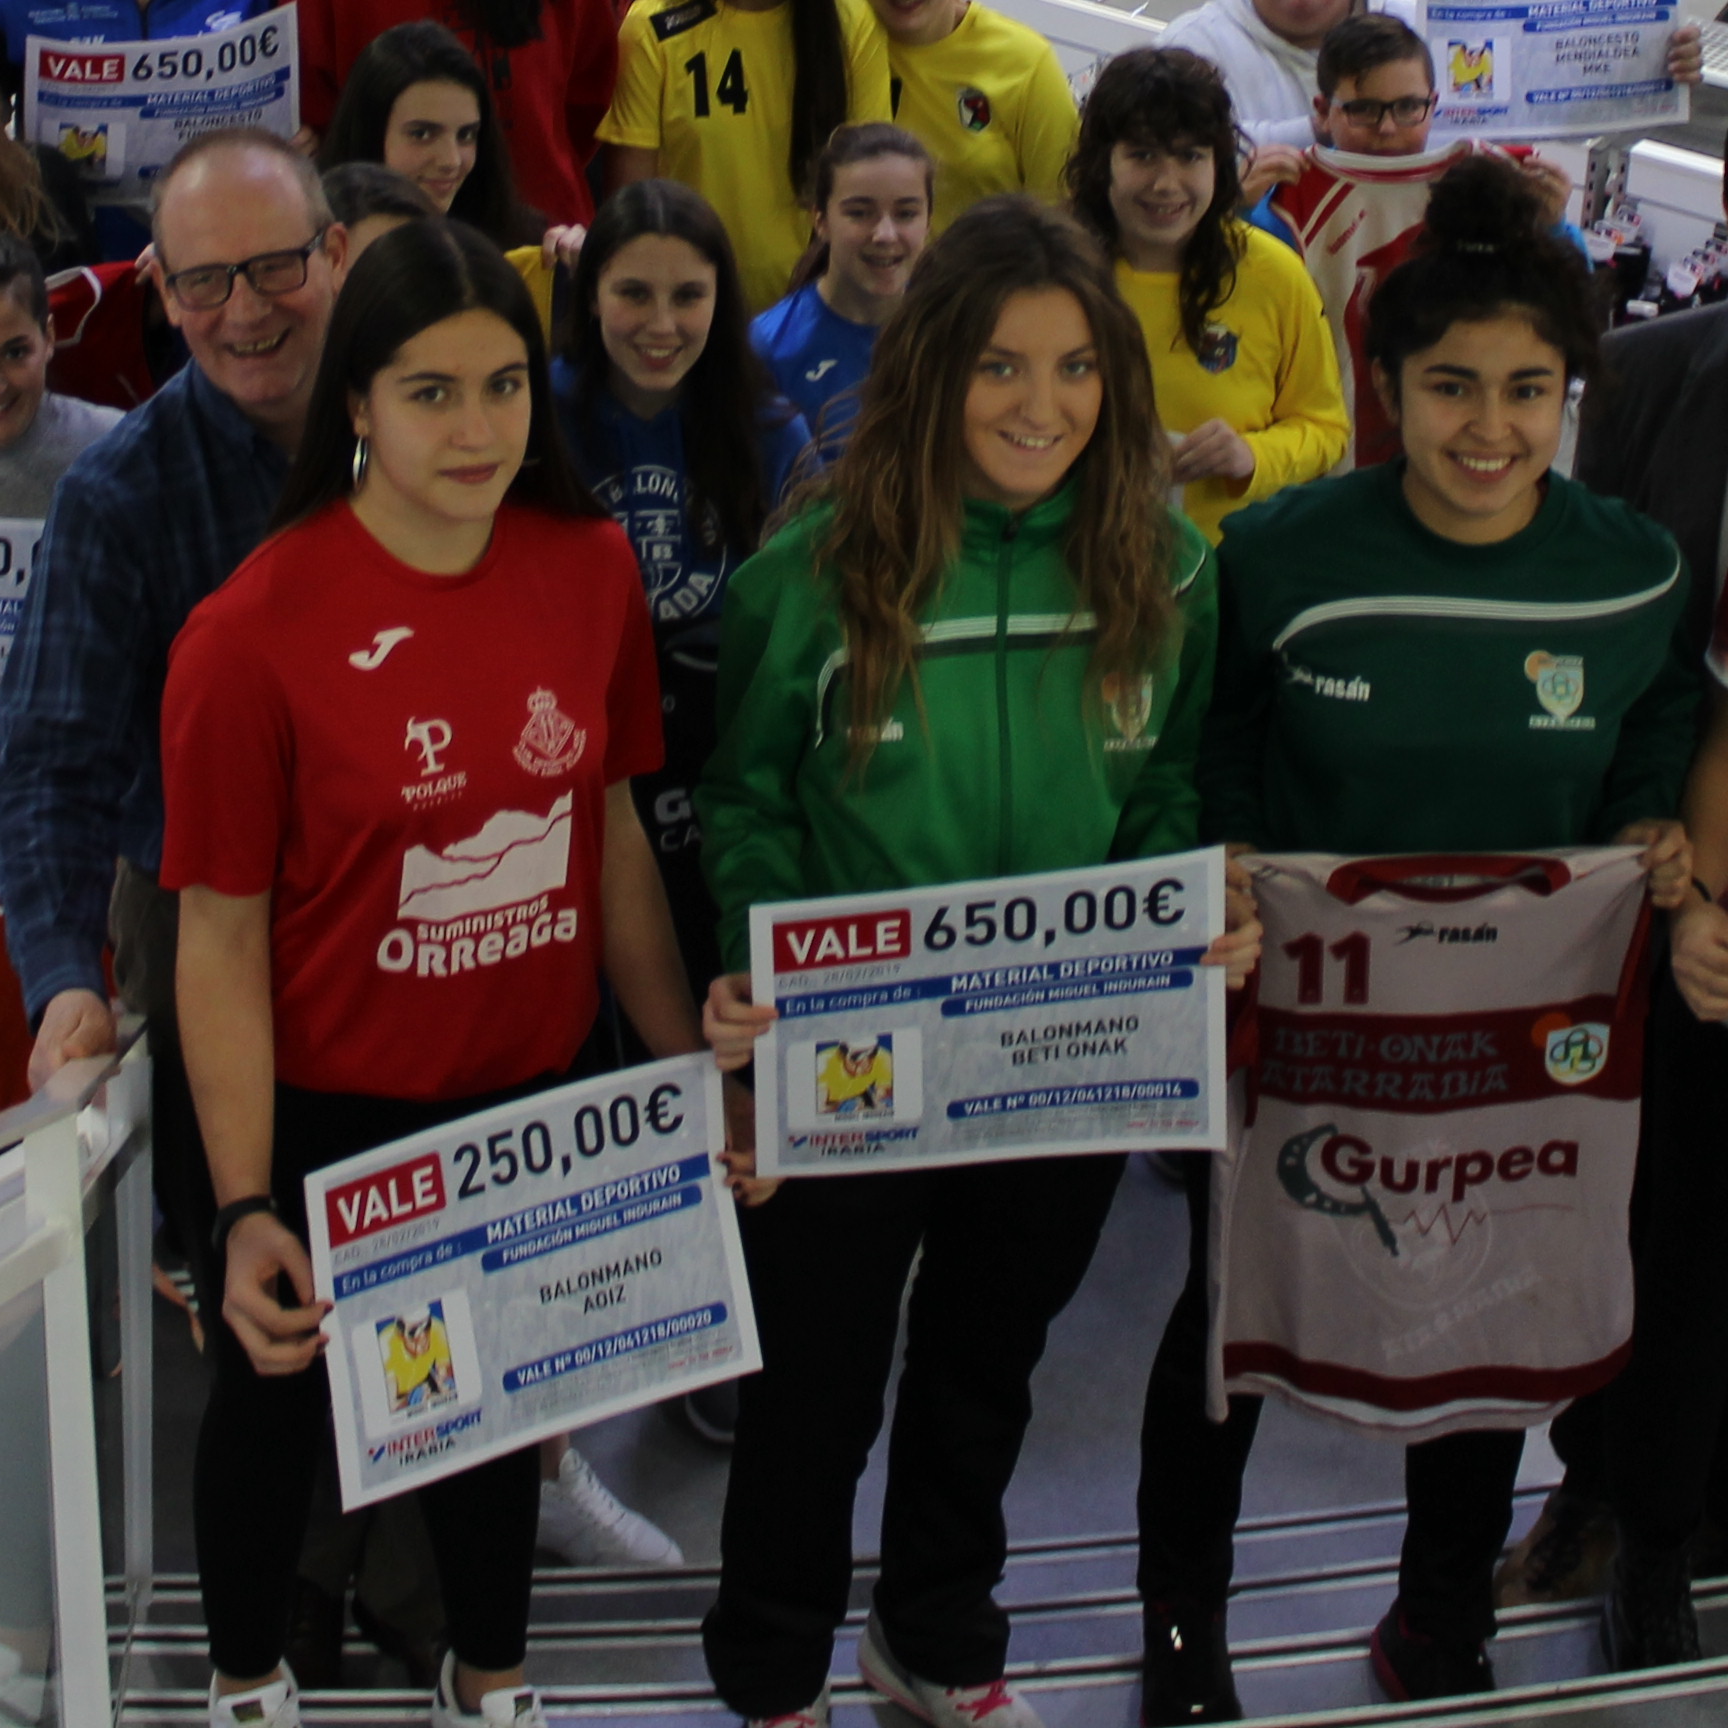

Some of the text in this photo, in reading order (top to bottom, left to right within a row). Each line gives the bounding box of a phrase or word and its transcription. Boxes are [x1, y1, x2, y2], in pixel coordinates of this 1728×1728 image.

[47, 25, 280, 82] VALE 650,00€
[684, 47, 749, 118] 14
[1313, 673, 1371, 703] rasán
[417, 894, 550, 943] SUMINISTROS
[786, 878, 1186, 966] VALE 650,00€
[1438, 921, 1497, 944] rasán
[951, 951, 1174, 994] MATERIAL DEPORTIVO
[1283, 931, 1371, 1005] 11
[1000, 1015, 1139, 1050] BALONMANO
[1012, 1037, 1129, 1067] BETI ONAK
[964, 1098, 1001, 1116] VALE
[337, 1083, 685, 1235] VALE 250,00€
[808, 1127, 919, 1147] INTERSPORT
[1321, 1134, 1580, 1202] Gurpea
[486, 1203, 577, 1244] MATERIAL
[580, 1164, 681, 1216] DEPORTIVO
[540, 1248, 663, 1306] BALONMANO
[584, 1283, 627, 1315] AOIZ
[517, 1363, 552, 1387] VALE
[387, 1407, 483, 1458] INTERSPORT
